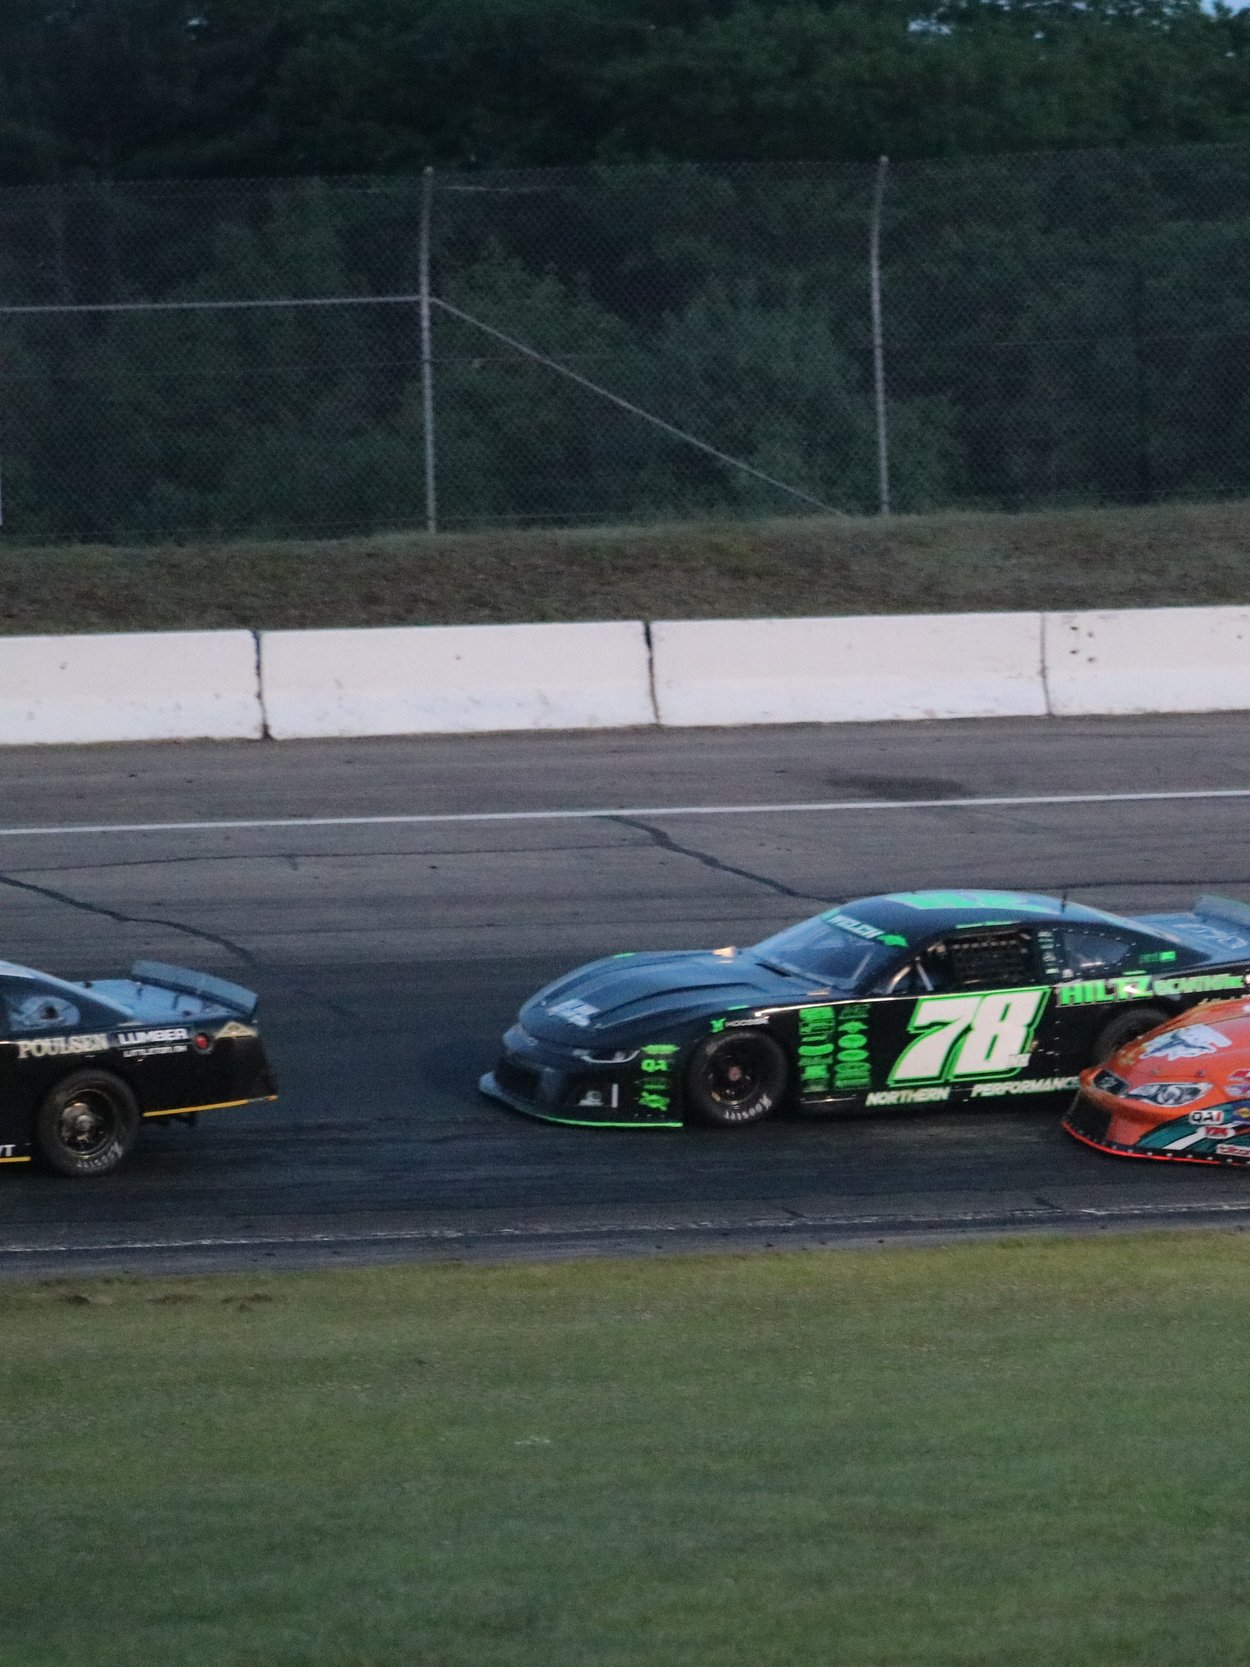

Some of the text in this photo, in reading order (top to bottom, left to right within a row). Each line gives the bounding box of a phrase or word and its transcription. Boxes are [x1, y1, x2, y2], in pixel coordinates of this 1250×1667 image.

[1054, 976, 1153, 1007] HILTZ
[117, 1028, 189, 1045] LUMBER
[886, 987, 1050, 1085] 78
[864, 1086, 950, 1107] NORTHERN
